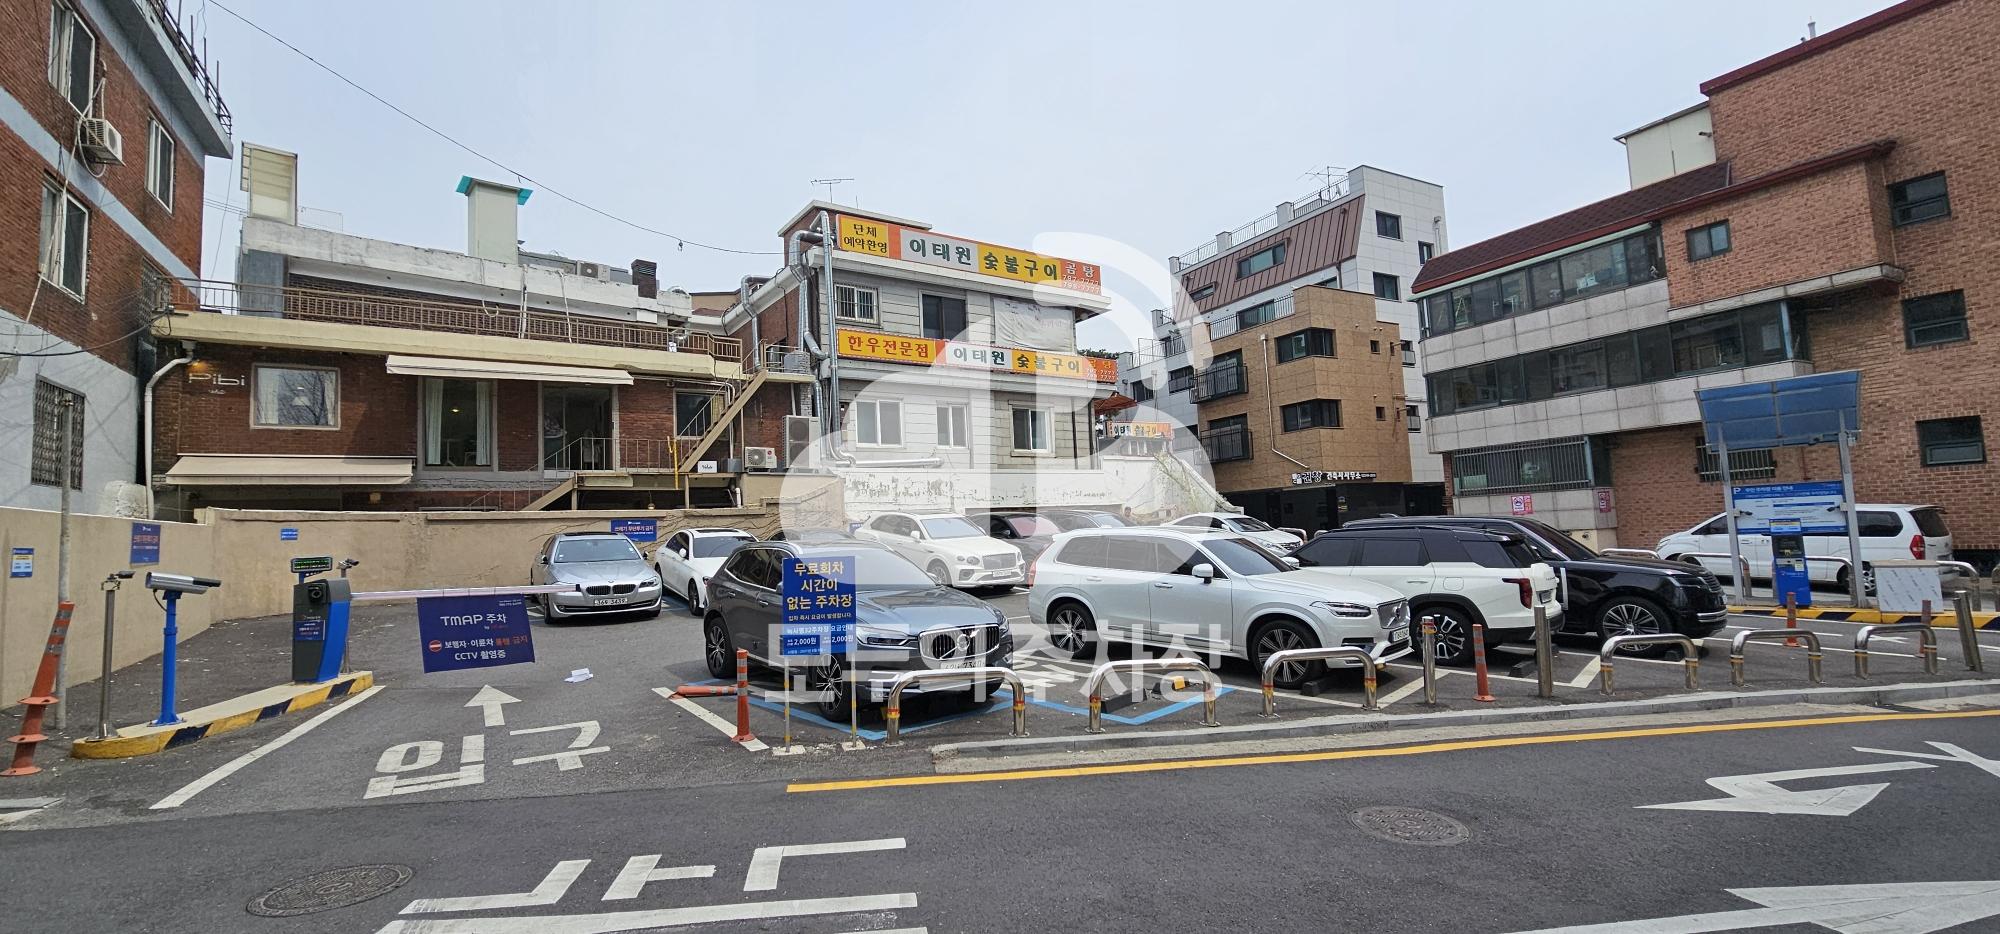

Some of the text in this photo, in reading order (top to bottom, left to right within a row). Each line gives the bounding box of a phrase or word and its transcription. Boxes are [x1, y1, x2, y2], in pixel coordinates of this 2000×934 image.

[853, 223, 877, 238] 단체
[843, 236, 887, 253] 예약환영
[909, 238, 1095, 281] 이태원 숯불구이 곰탕
[847, 335, 929, 359] 한우전문점
[953, 347, 1005, 366] 이태원
[1018, 353, 1080, 374] 숯불구이
[794, 561, 844, 576] 무료회차
[801, 578, 838, 592] 시간이
[786, 594, 853, 610] 없는 주차장
[440, 613, 507, 626] TMAP 주차
[454, 649, 506, 661] CCTV 촬영중
